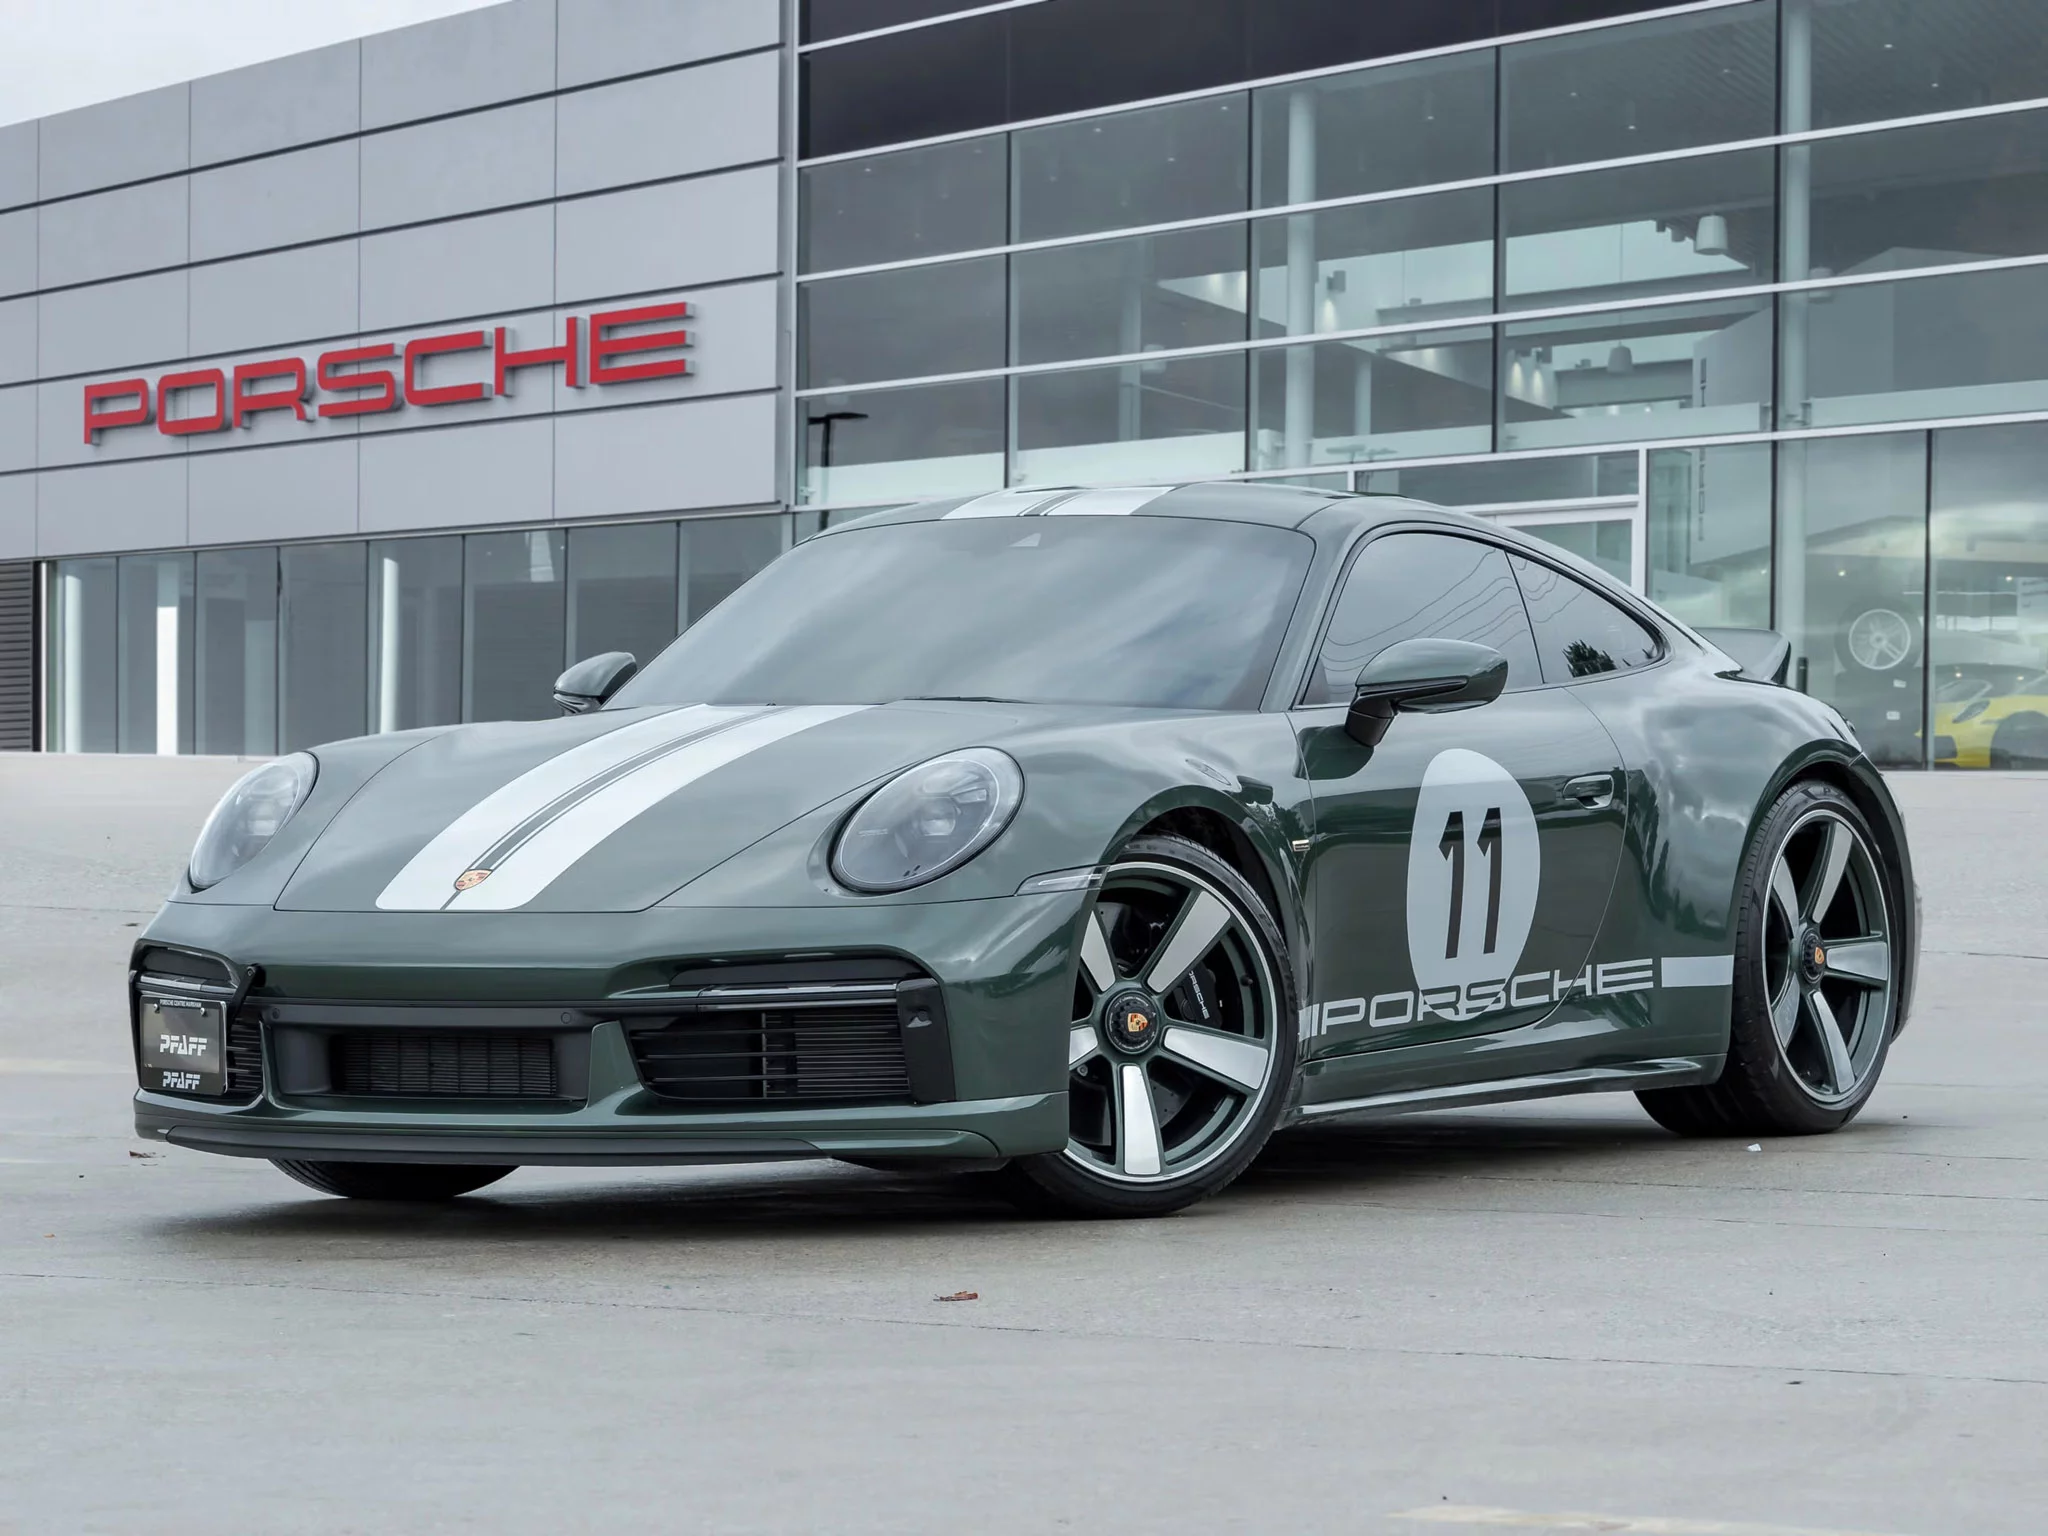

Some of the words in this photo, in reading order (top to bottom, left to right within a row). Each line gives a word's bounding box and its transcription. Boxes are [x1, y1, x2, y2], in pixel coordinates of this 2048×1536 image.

[84, 301, 694, 446] PORSCHE
[1438, 807, 1502, 959] 11
[1320, 958, 1653, 1035] PORSCHE
[159, 1034, 208, 1056] PFAFF
[162, 1071, 201, 1090] PFAFF
